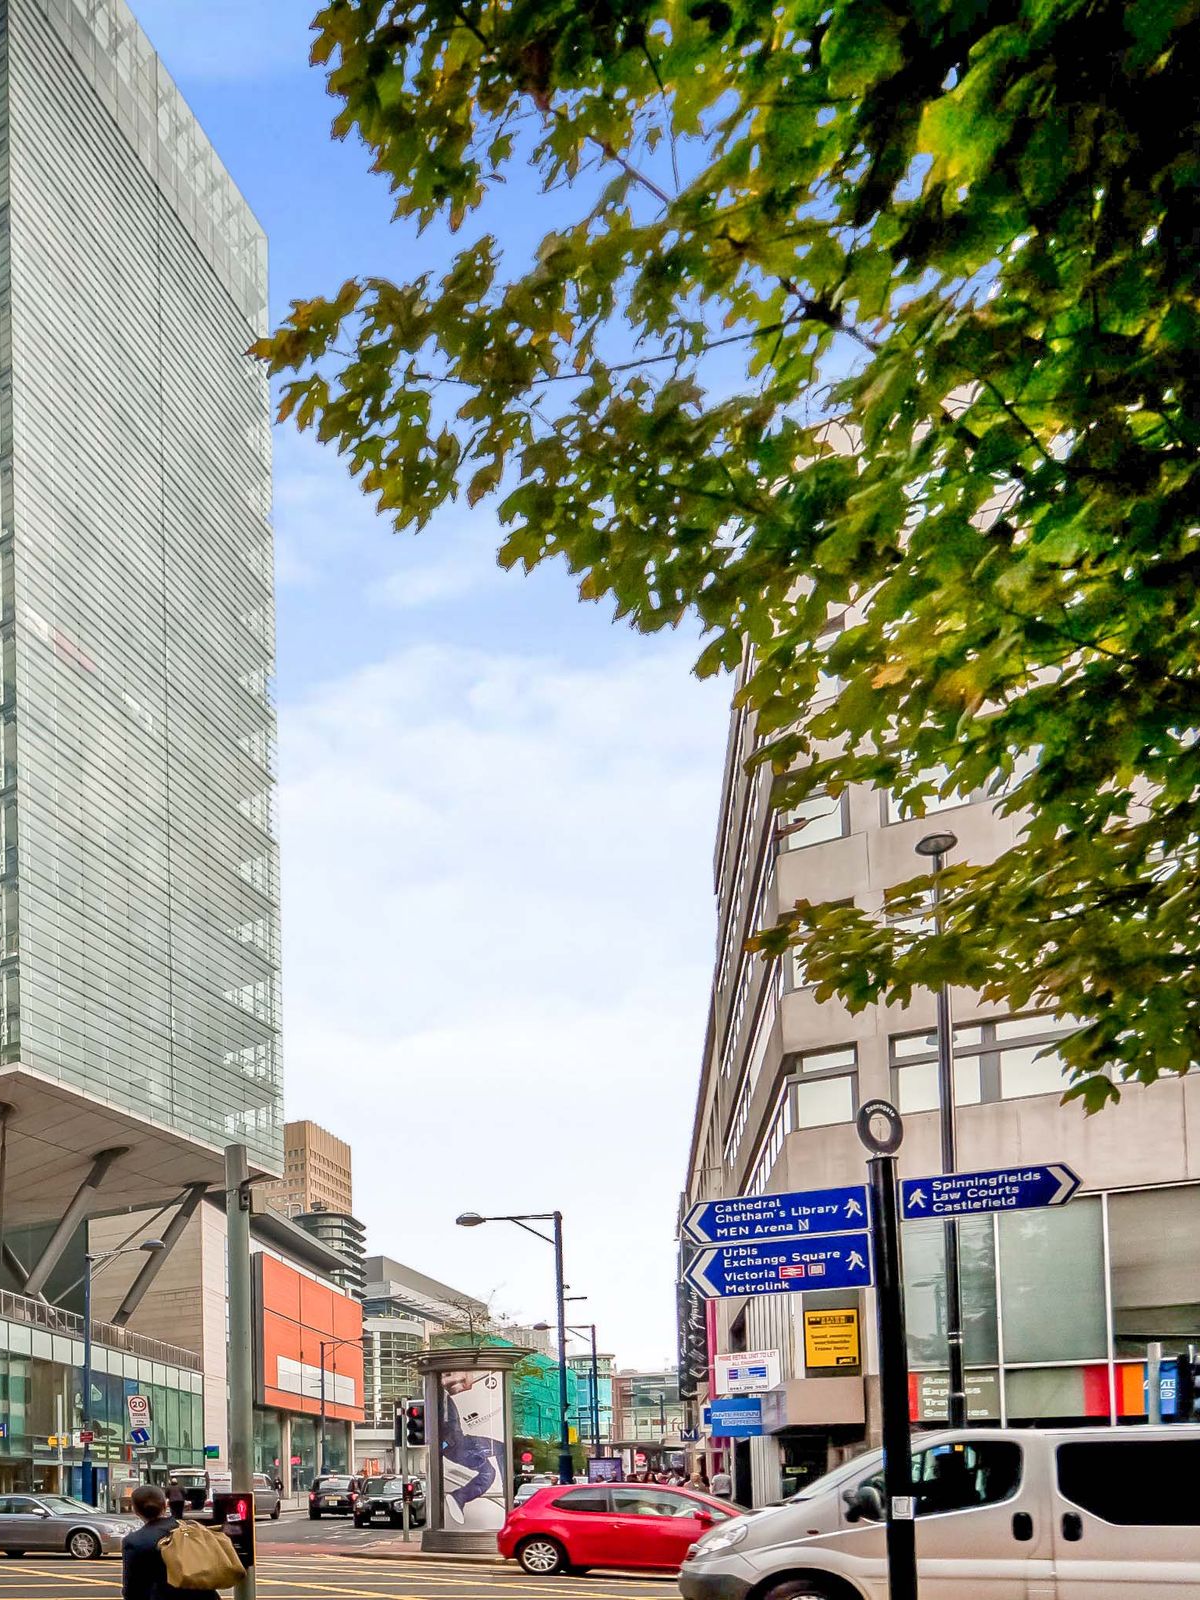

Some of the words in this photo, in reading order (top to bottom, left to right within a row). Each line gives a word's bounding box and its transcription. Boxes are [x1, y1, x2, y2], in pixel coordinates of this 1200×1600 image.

[932, 1171, 1041, 1191] Spinningfields
[932, 1192, 960, 1202] Law
[967, 1185, 1020, 1198] Courts
[715, 1198, 782, 1213] Cathedral
[932, 1196, 1016, 1212] Castlefield
[716, 1209, 786, 1224] Chetham's
[792, 1204, 838, 1217] Library
[716, 1226, 749, 1238] MEN
[754, 1224, 794, 1234] Arena
[724, 1248, 758, 1257] Urbis
[724, 1256, 786, 1268] Exchange
[792, 1250, 841, 1262] Square
[724, 1270, 776, 1282] Victoria
[726, 1281, 790, 1294] Metrolink
[923, 1376, 994, 1384] Amican
[922, 1388, 981, 1396] Expss
